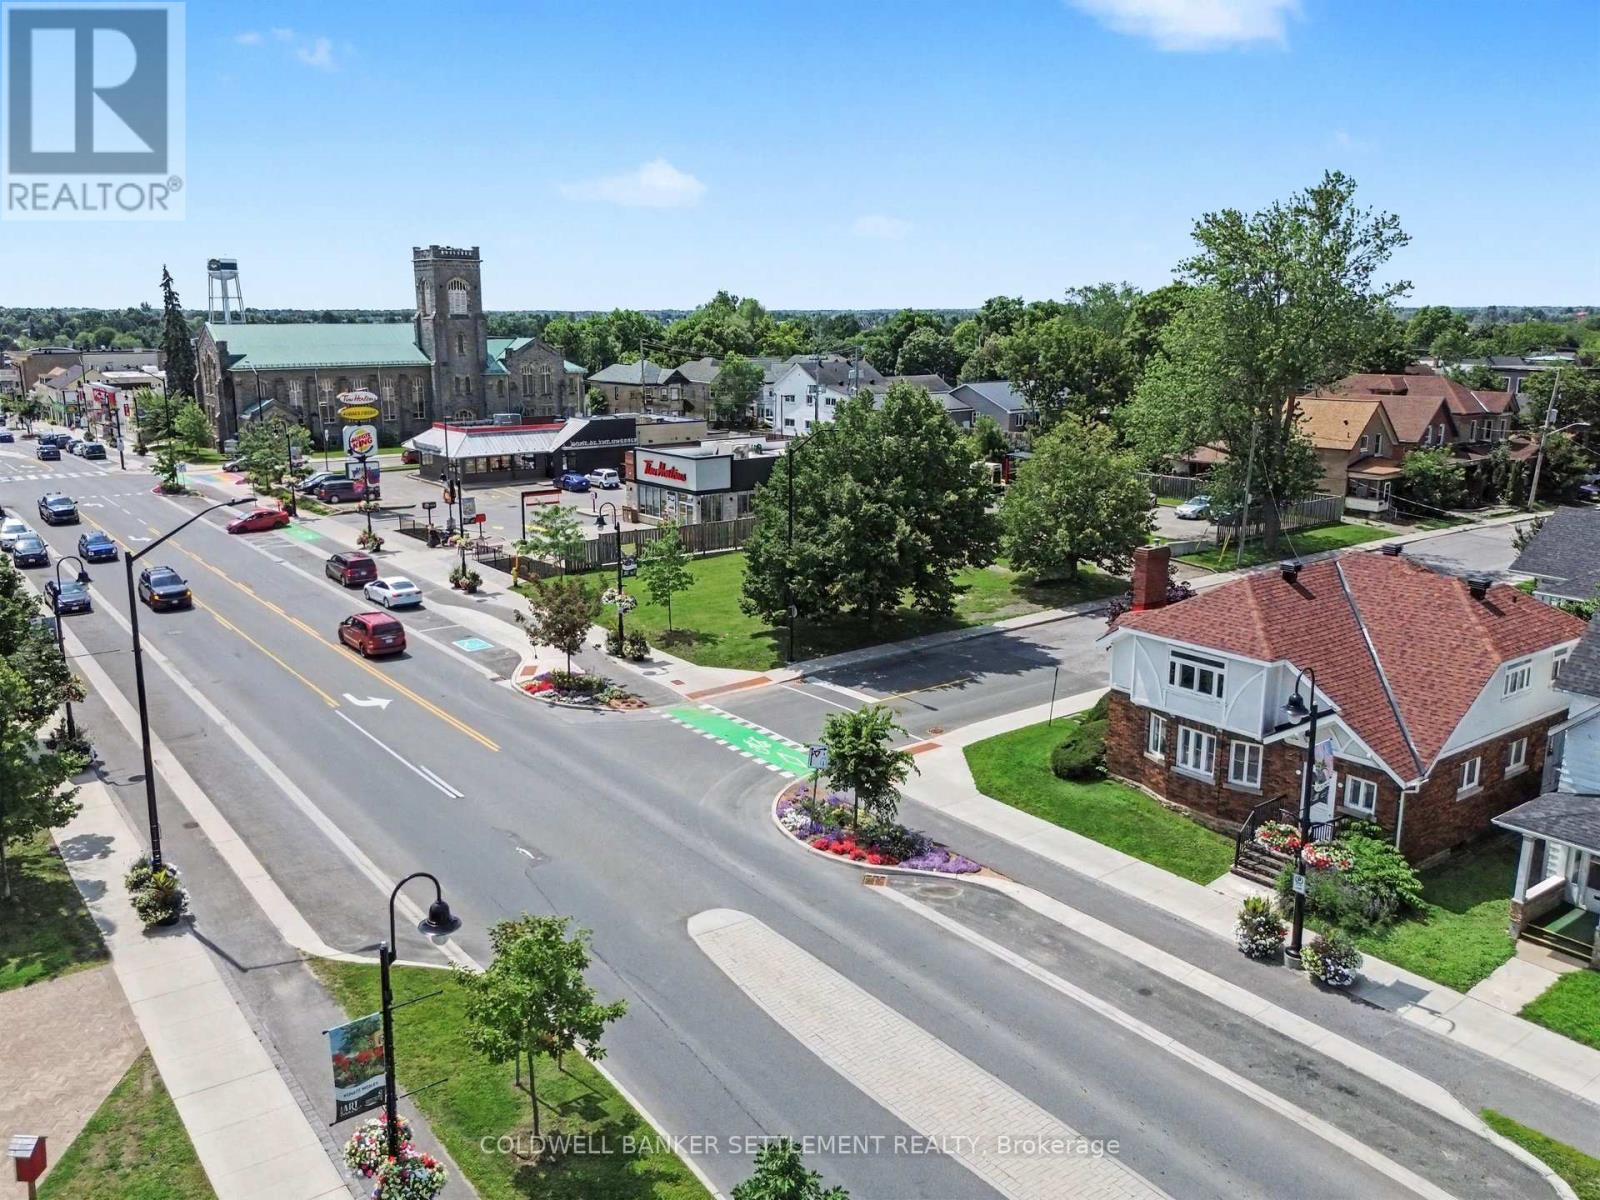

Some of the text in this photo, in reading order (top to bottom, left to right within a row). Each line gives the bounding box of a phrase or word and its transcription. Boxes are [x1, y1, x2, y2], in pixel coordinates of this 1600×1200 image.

[352, 438, 374, 449] KING
[643, 459, 687, 482] Tim Hortons
